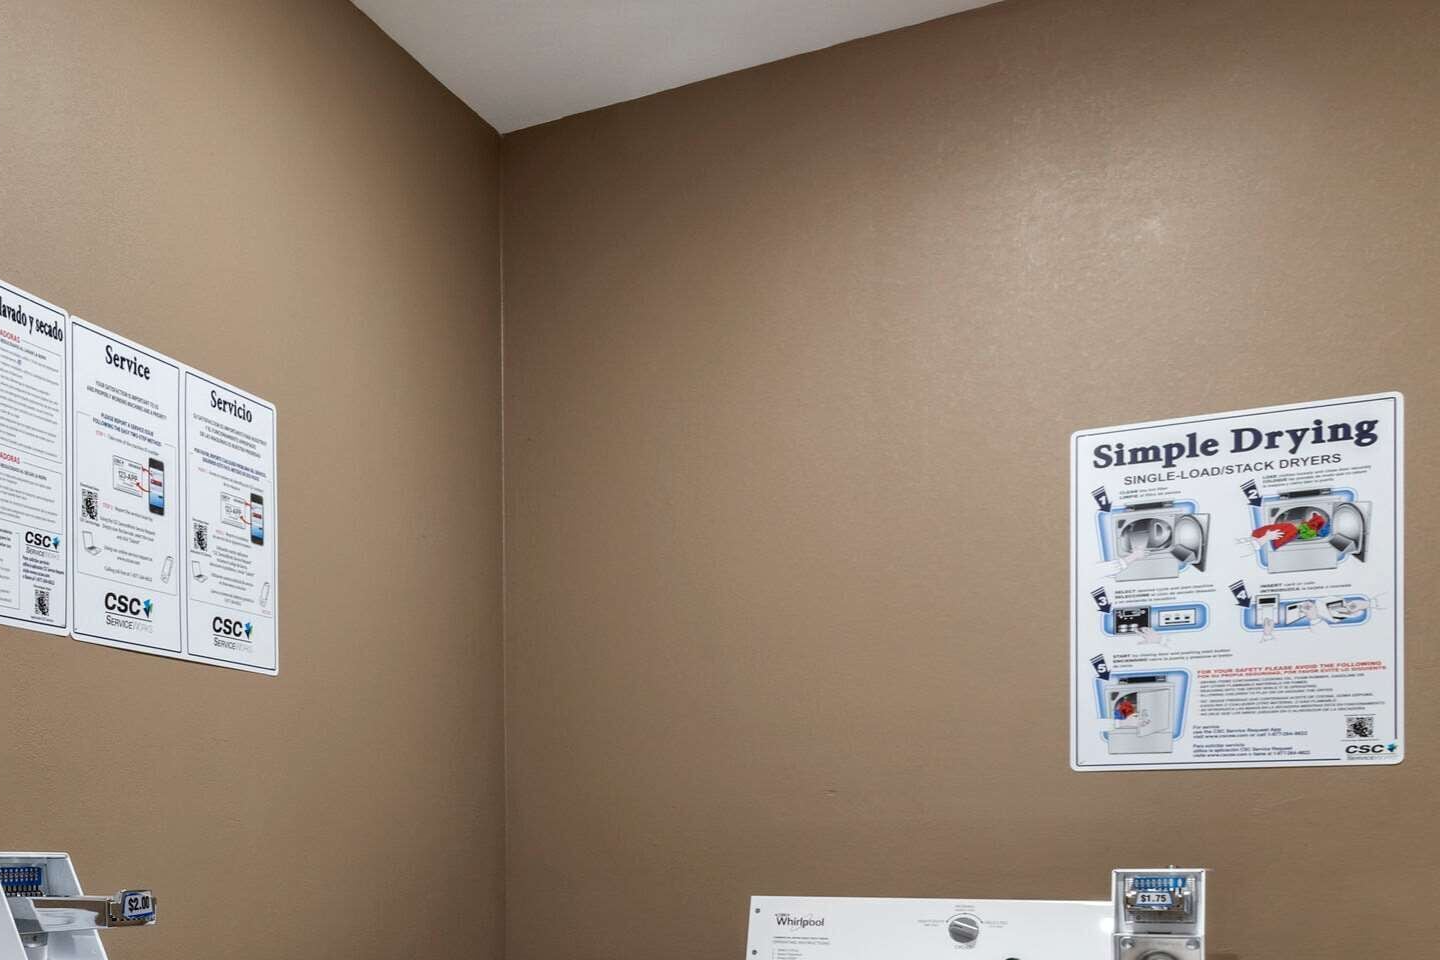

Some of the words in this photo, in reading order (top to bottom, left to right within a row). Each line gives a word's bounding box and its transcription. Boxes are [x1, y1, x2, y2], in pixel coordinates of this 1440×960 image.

[28, 316, 34, 335] y
[35, 319, 64, 342] secado
[105, 345, 150, 380] Service
[210, 390, 252, 423] Servicio
[1093, 432, 1219, 469] Simple
[1230, 418, 1378, 455] Drying
[1124, 460, 1275, 486] SINGLE-LOAD/STACK
[1279, 453, 1342, 469] DRYERS
[1247, 489, 1258, 500] 2
[25, 531, 51, 548] CSC
[104, 592, 141, 615] CSC
[1098, 596, 1107, 606] 3
[212, 616, 243, 637] CSC
[1097, 663, 1107, 673] 5
[1345, 744, 1385, 754] CSC
[128, 895, 150, 913] $2.00
[1140, 894, 1167, 903] $1.75
[776, 917, 824, 928] Whirlpool
